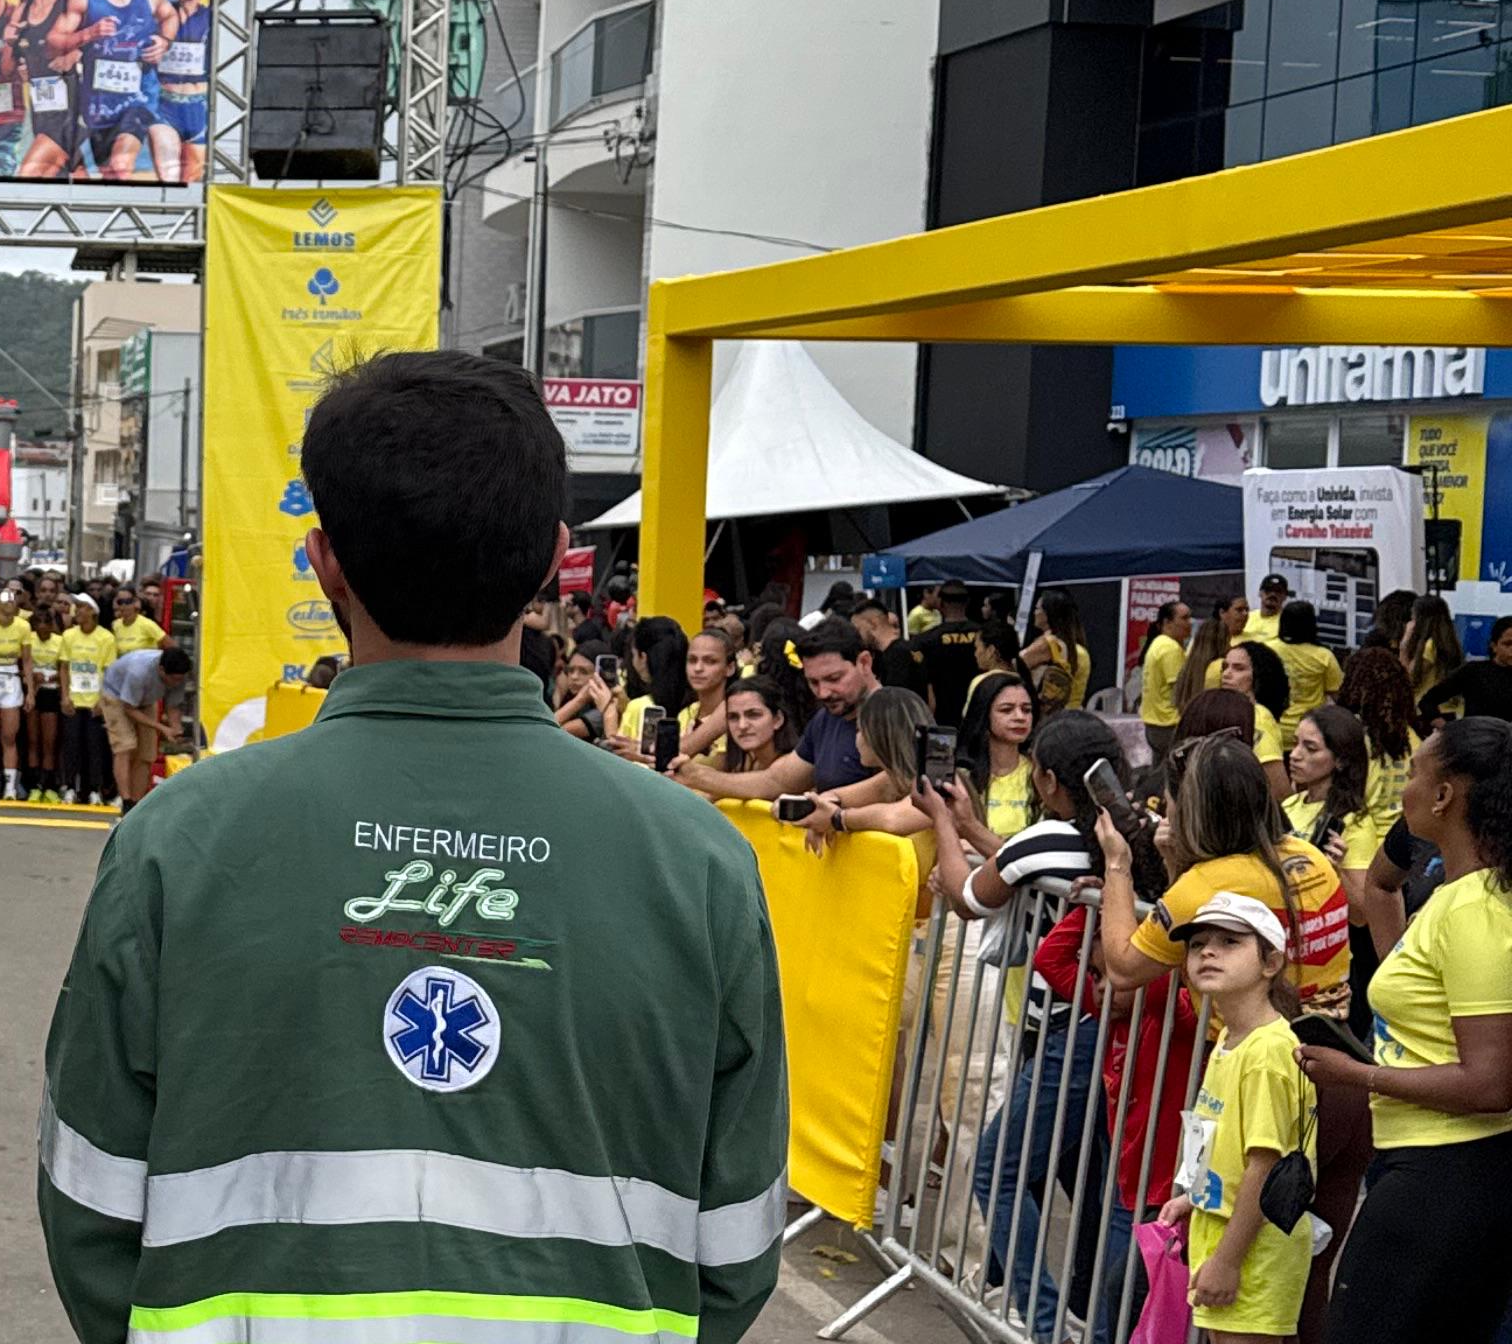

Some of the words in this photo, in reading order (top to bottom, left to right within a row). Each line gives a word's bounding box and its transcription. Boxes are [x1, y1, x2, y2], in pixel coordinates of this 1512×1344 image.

[293, 231, 356, 247] LEMOS
[574, 385, 633, 405] JATO
[1257, 487, 1280, 505] Faça
[1282, 489, 1308, 503] como
[1360, 486, 1394, 502] invista
[1271, 509, 1286, 521] em
[1288, 505, 1324, 523] Energia
[1326, 505, 1353, 520] Solar
[1355, 508, 1378, 520] com
[1285, 523, 1328, 539] Carvalho
[1330, 523, 1374, 539] Teixeira!
[354, 820, 551, 863] ENFERMEIRO
[343, 859, 520, 927] Life
